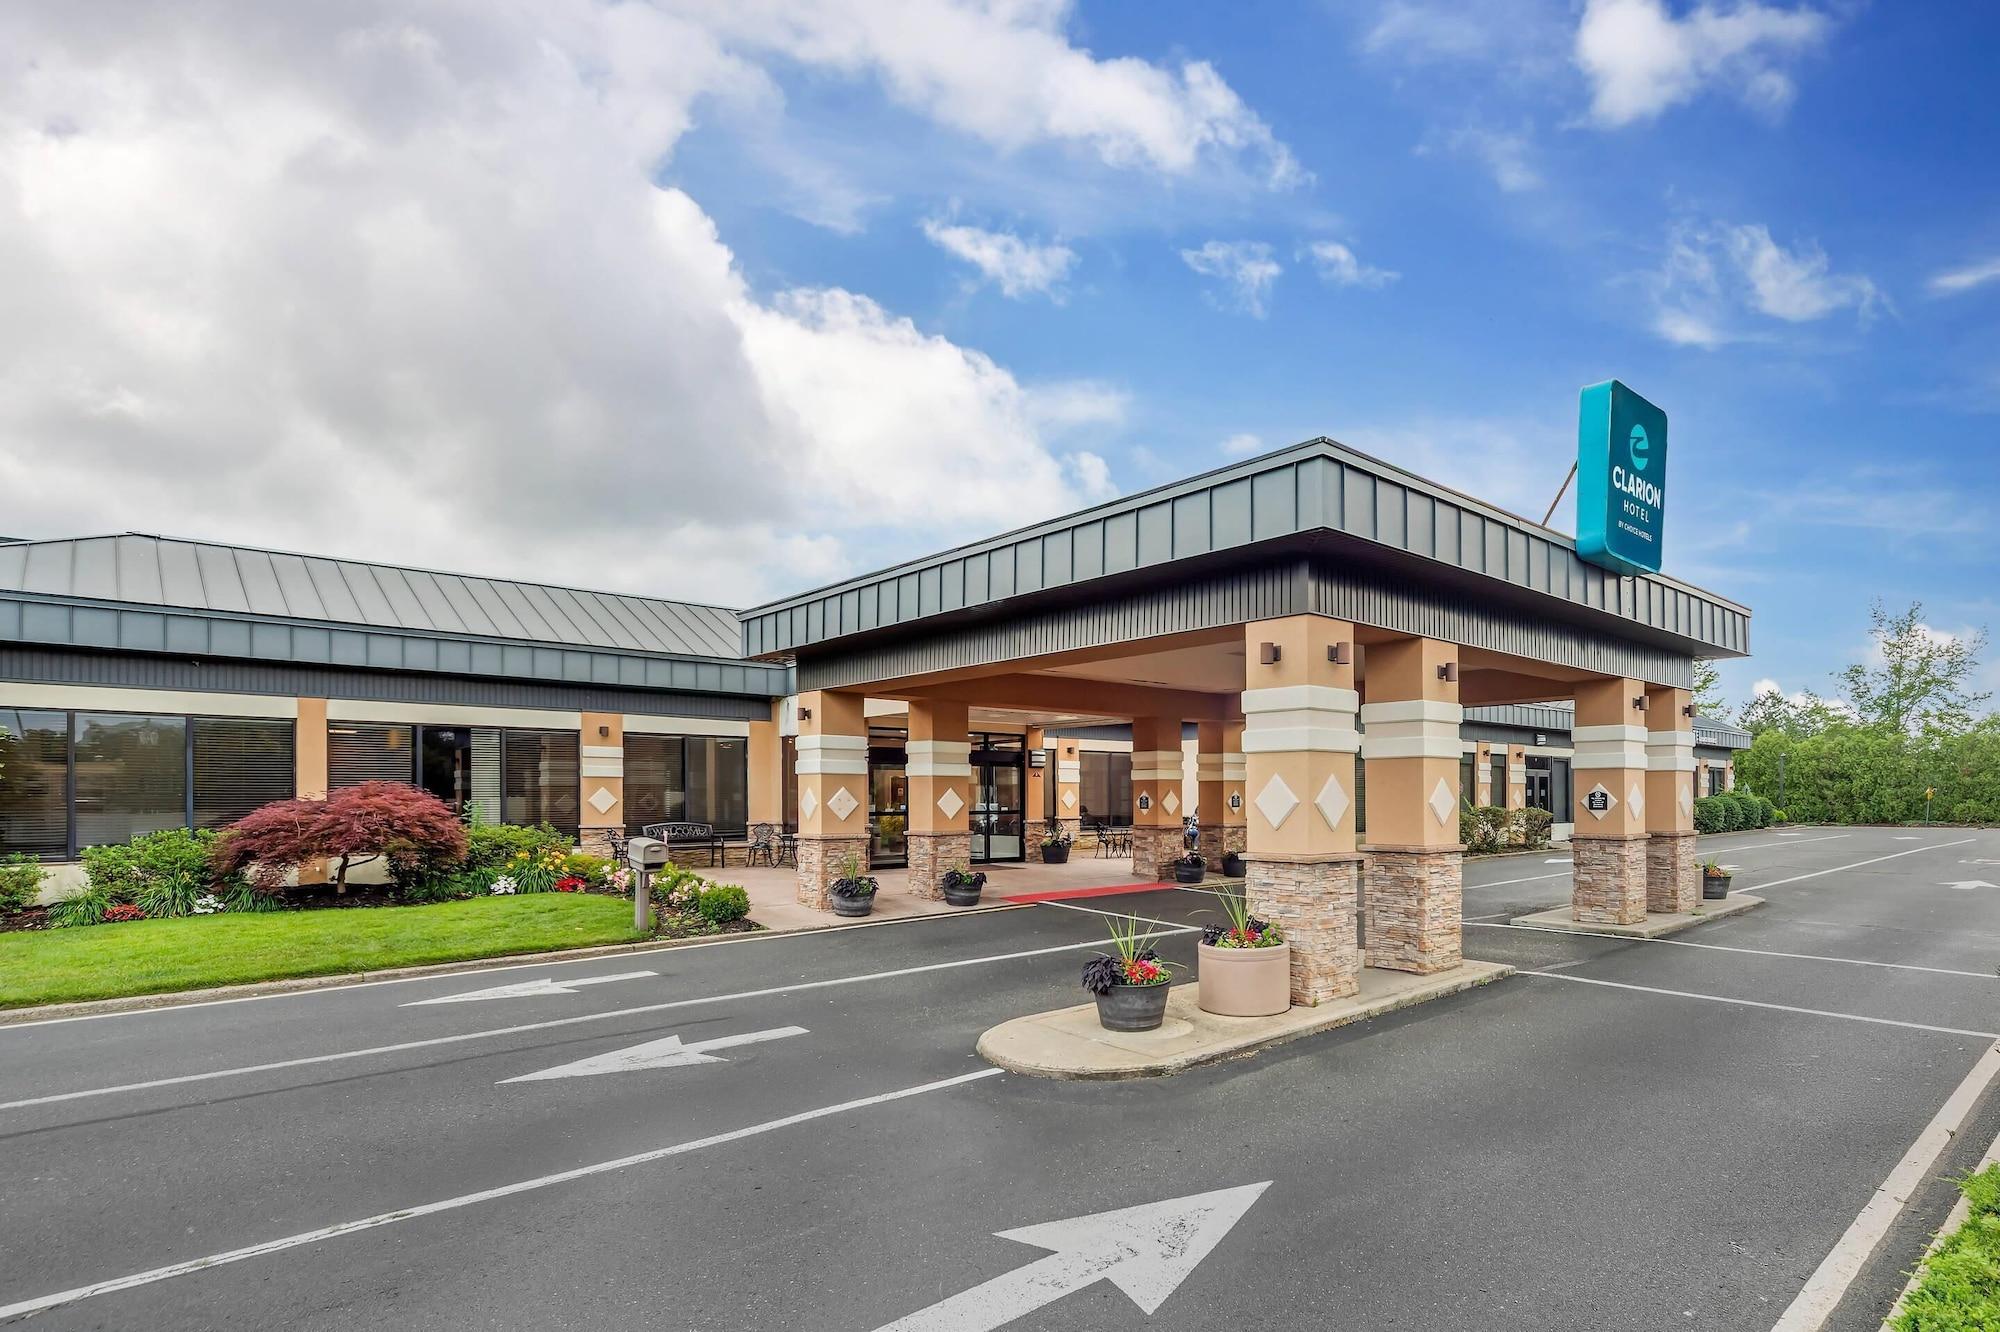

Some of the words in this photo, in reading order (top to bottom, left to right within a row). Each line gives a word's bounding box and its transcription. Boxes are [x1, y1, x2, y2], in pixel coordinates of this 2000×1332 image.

[1612, 465, 1661, 510] CLARION
[1623, 499, 1649, 523] HOTEL
[1618, 520, 1624, 529] BY
[1624, 523, 1638, 536] CHOICE
[1639, 530, 1653, 542] HOTELS
